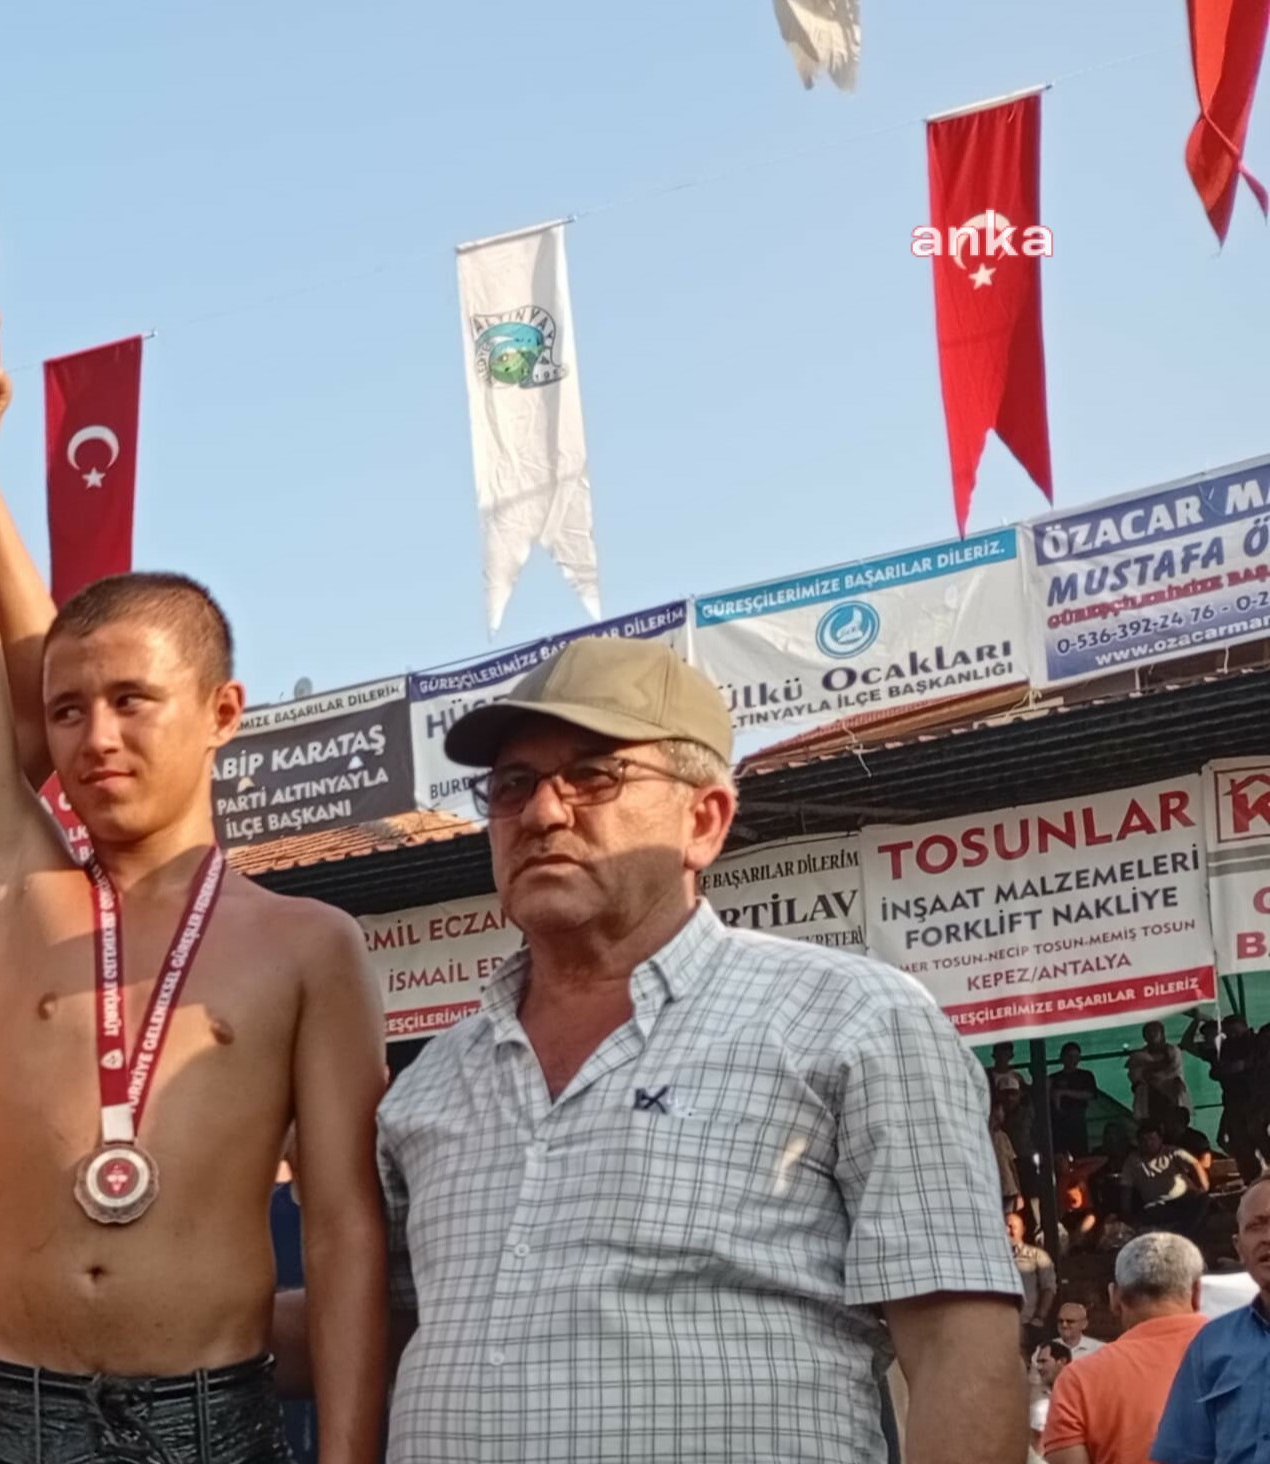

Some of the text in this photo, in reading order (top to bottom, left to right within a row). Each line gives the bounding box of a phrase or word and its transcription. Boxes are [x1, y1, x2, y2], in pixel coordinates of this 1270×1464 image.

[1042, 495, 1203, 560] ÖZACAR
[702, 577, 841, 619] GÜREŞÇİLERİMİZE
[844, 558, 932, 588] BAŞARILAR
[1047, 536, 1224, 607] MUSTAFA
[419, 650, 538, 693] GÜREŞÇİLERİMİZE
[731, 662, 1014, 729] TINYAYLA İLÇE BAŞKANLIĞI
[274, 697, 343, 728] BAŞARILAR
[271, 724, 386, 772] KARATAŞ
[216, 766, 389, 816] PARTİ ALTINYAYLA
[225, 799, 352, 841] İLÇE BAŞKANI
[877, 790, 1197, 881] TOSUNLAR
[713, 860, 794, 889] BAŞARILAR
[797, 849, 860, 874] DİLERİM
[881, 887, 985, 925] İNŞAAT
[994, 844, 1199, 904] MALZEMELERİ
[906, 886, 1179, 950] FORKLİFT NAKLİYE
[1142, 919, 1196, 939] TOSUN
[388, 958, 469, 993] İSMAİL
[967, 952, 1132, 992] KEPEZ/ANTALYA
[1057, 988, 1136, 1012] BAŞARILAR
[1144, 976, 1200, 998] DİLERİZ
[143, 969, 180, 1050] GELENEKSEL
